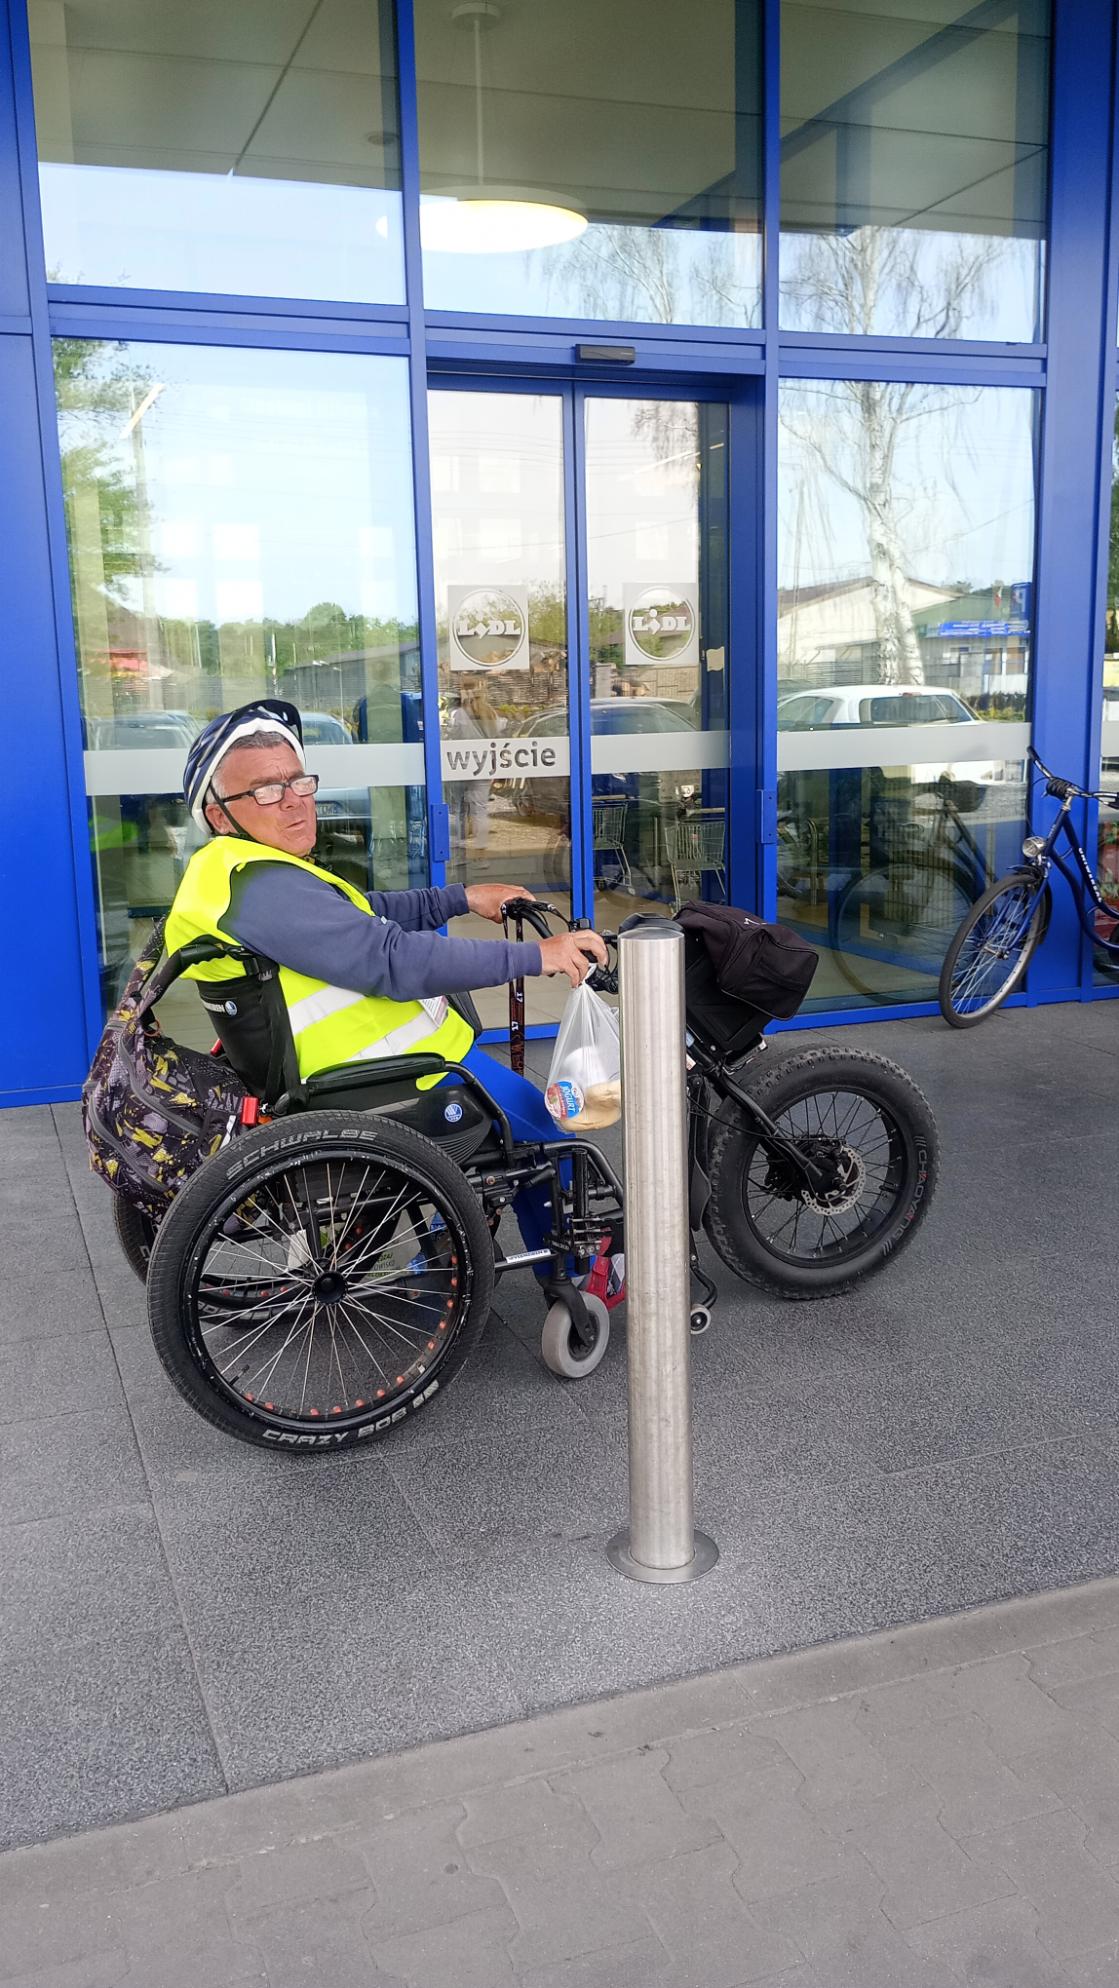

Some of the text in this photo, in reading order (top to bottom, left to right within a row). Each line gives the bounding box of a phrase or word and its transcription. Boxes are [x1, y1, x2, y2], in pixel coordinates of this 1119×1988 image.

[446, 741, 556, 776] wyjście
[226, 1128, 379, 1181] SCHWALBE
[892, 1149, 928, 1241] CHAOYANG
[262, 1405, 408, 1446] CRAZY BOB
